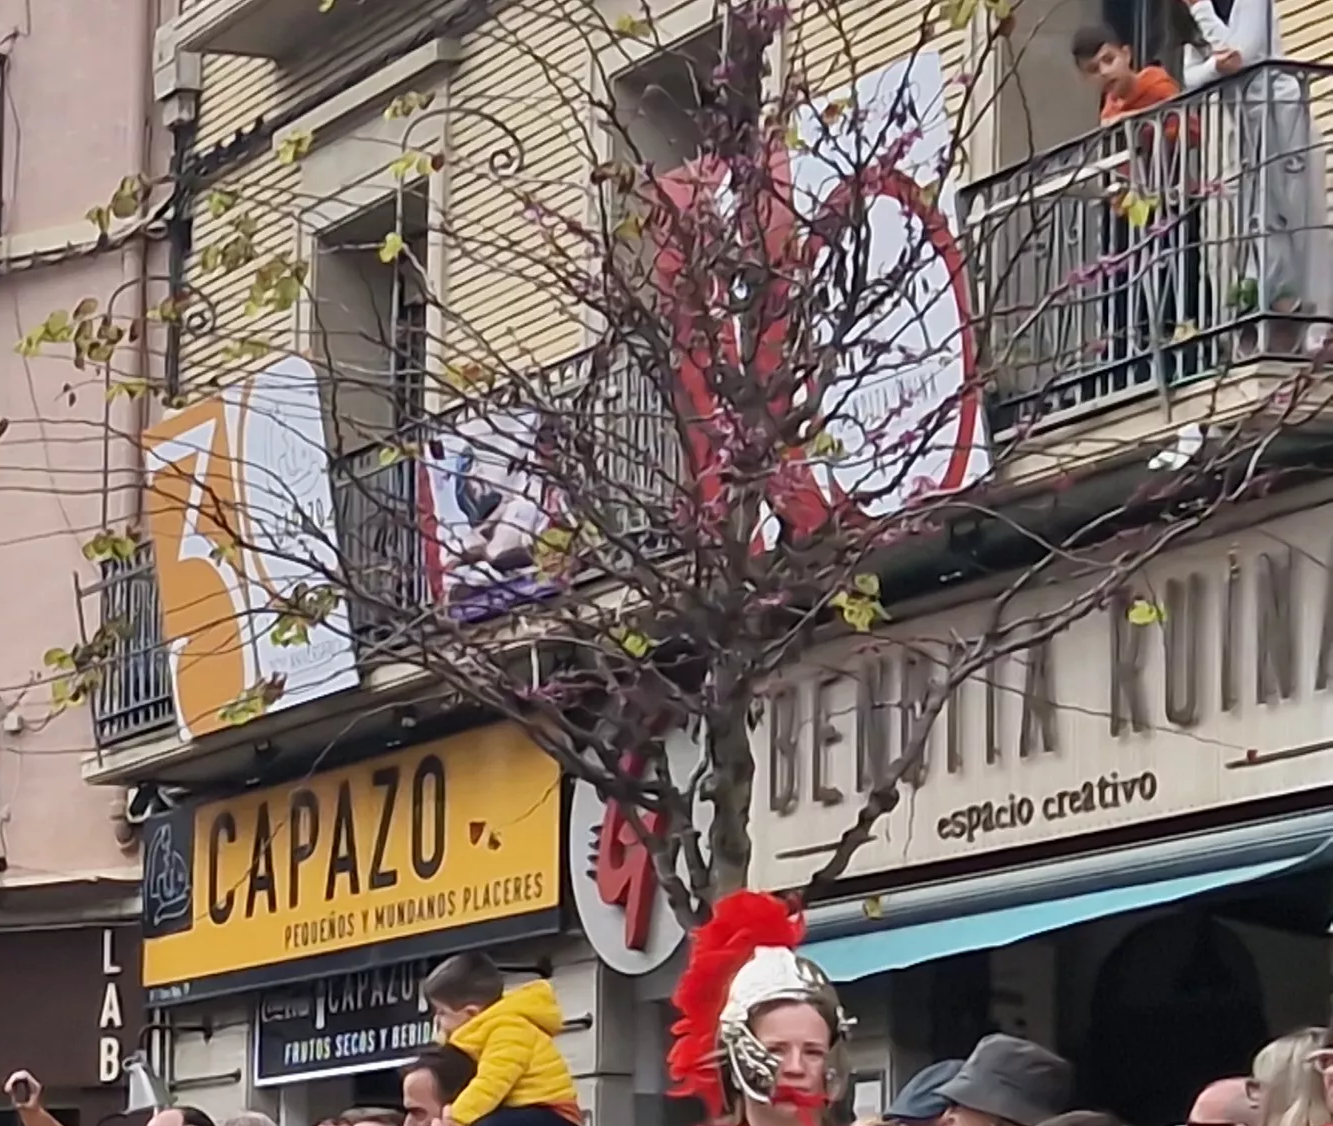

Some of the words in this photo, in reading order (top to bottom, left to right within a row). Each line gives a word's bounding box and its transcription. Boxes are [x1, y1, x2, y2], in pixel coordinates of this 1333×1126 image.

[208, 753, 446, 925] CAPAZO
[936, 793, 1035, 843] espacio
[1043, 769, 1158, 824] creativo
[284, 911, 355, 950] PEQUEÑOS
[361, 908, 371, 933] Y
[374, 892, 457, 928] MUNDANOS
[463, 871, 544, 914] PLACERES
[98, 928, 123, 1084] LAB
[284, 1035, 331, 1066] FRUTOS
[334, 1030, 376, 1058] SECOS
[379, 1027, 390, 1050] Y
